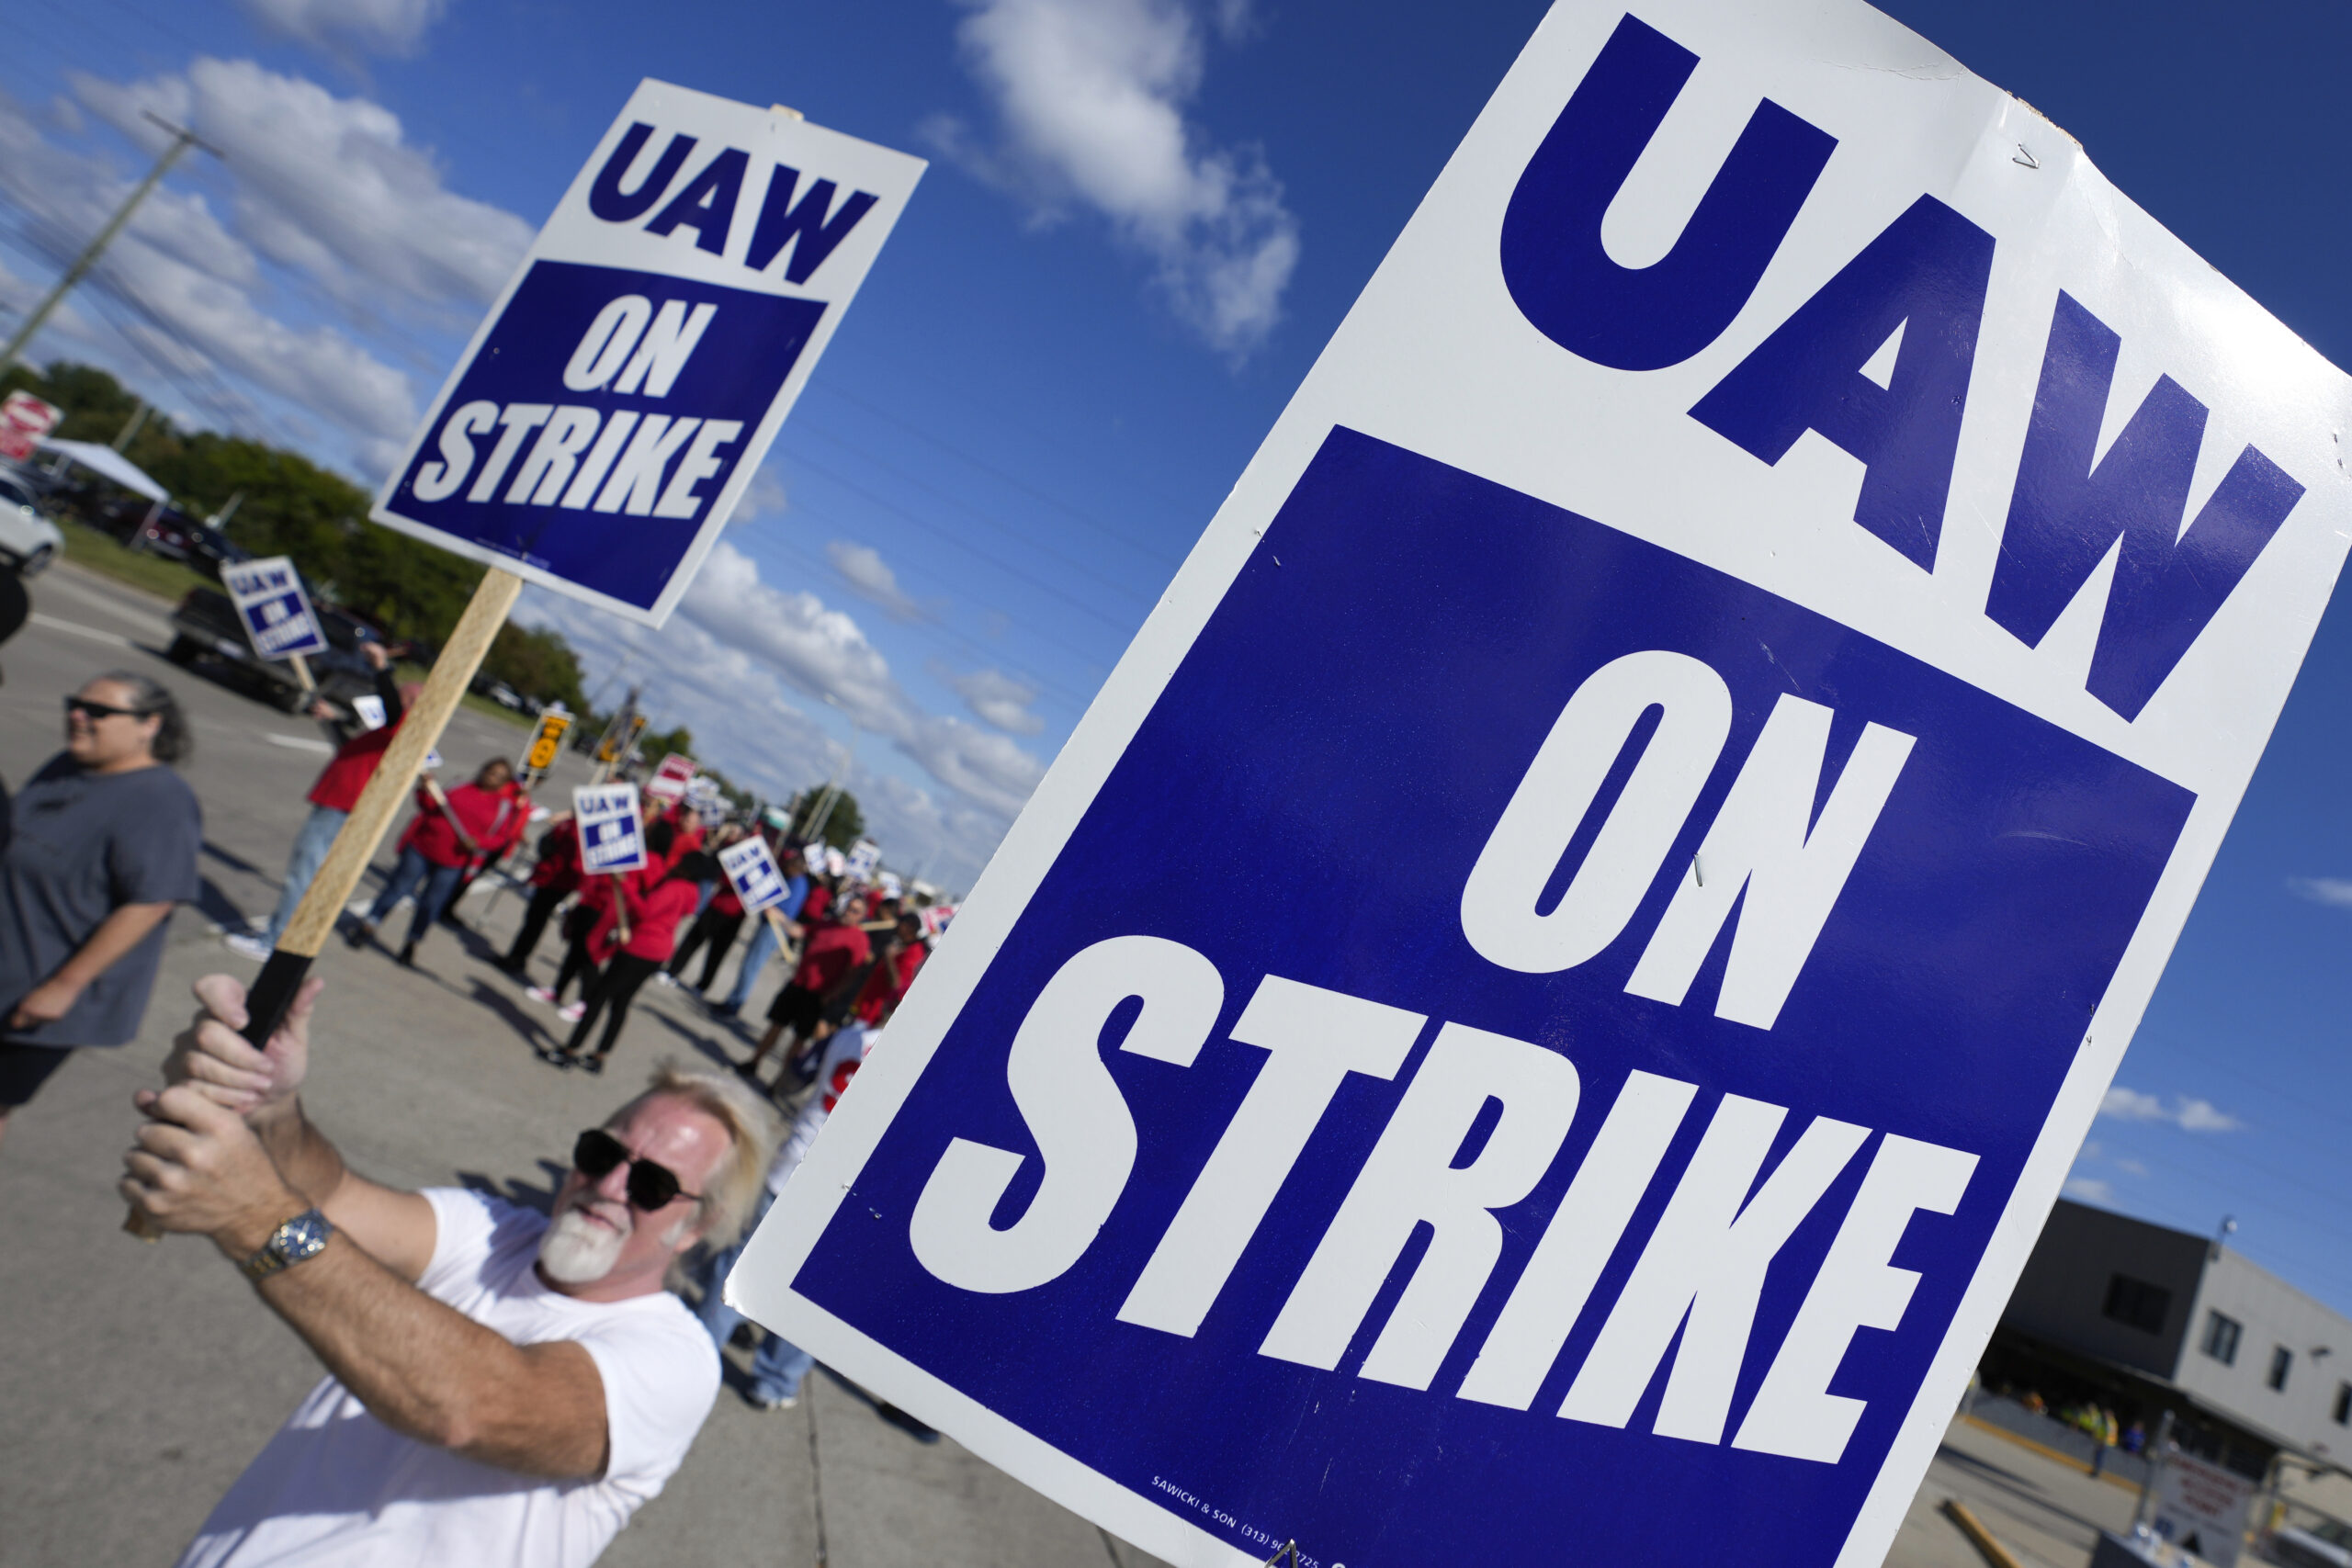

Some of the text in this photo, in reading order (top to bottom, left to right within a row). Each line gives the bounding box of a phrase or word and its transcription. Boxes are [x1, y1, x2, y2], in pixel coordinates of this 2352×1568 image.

[588, 120, 879, 286] UAW
[564, 295, 718, 398] ON
[1500, 11, 2306, 724] UAW
[413, 400, 743, 519] STRIKE
[231, 570, 288, 595] UAW
[579, 793, 628, 815] UAW
[1461, 650, 1918, 1032] ON
[910, 934, 1982, 1465] STRIKE
[1151, 1475, 1200, 1507] SAWICKI
[1201, 1503, 1210, 1514] &
[1212, 1509, 1237, 1528] SON
[1241, 1523, 1270, 1545] (313)
